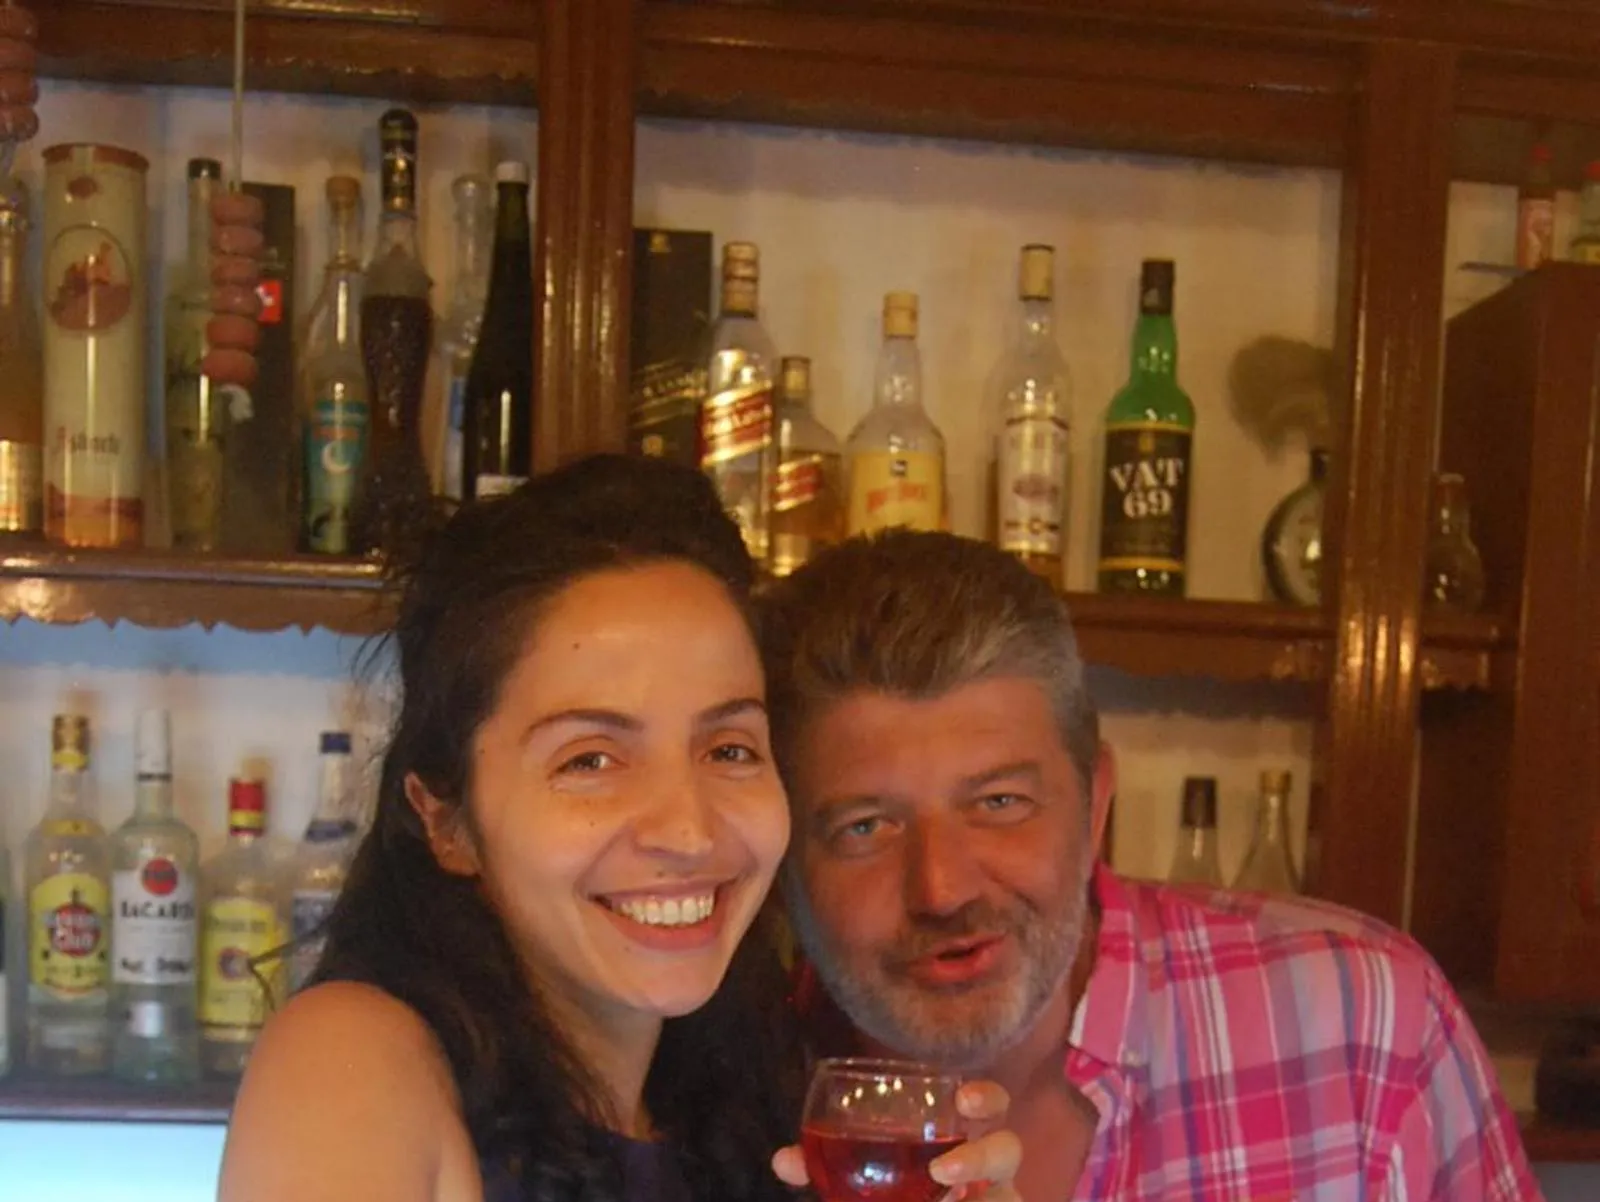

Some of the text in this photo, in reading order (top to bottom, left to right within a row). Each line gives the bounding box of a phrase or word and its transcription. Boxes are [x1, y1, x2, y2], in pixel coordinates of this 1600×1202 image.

[1110, 458, 1184, 491] VAT
[1123, 489, 1172, 518] 69
[121, 901, 195, 920] BACARD
